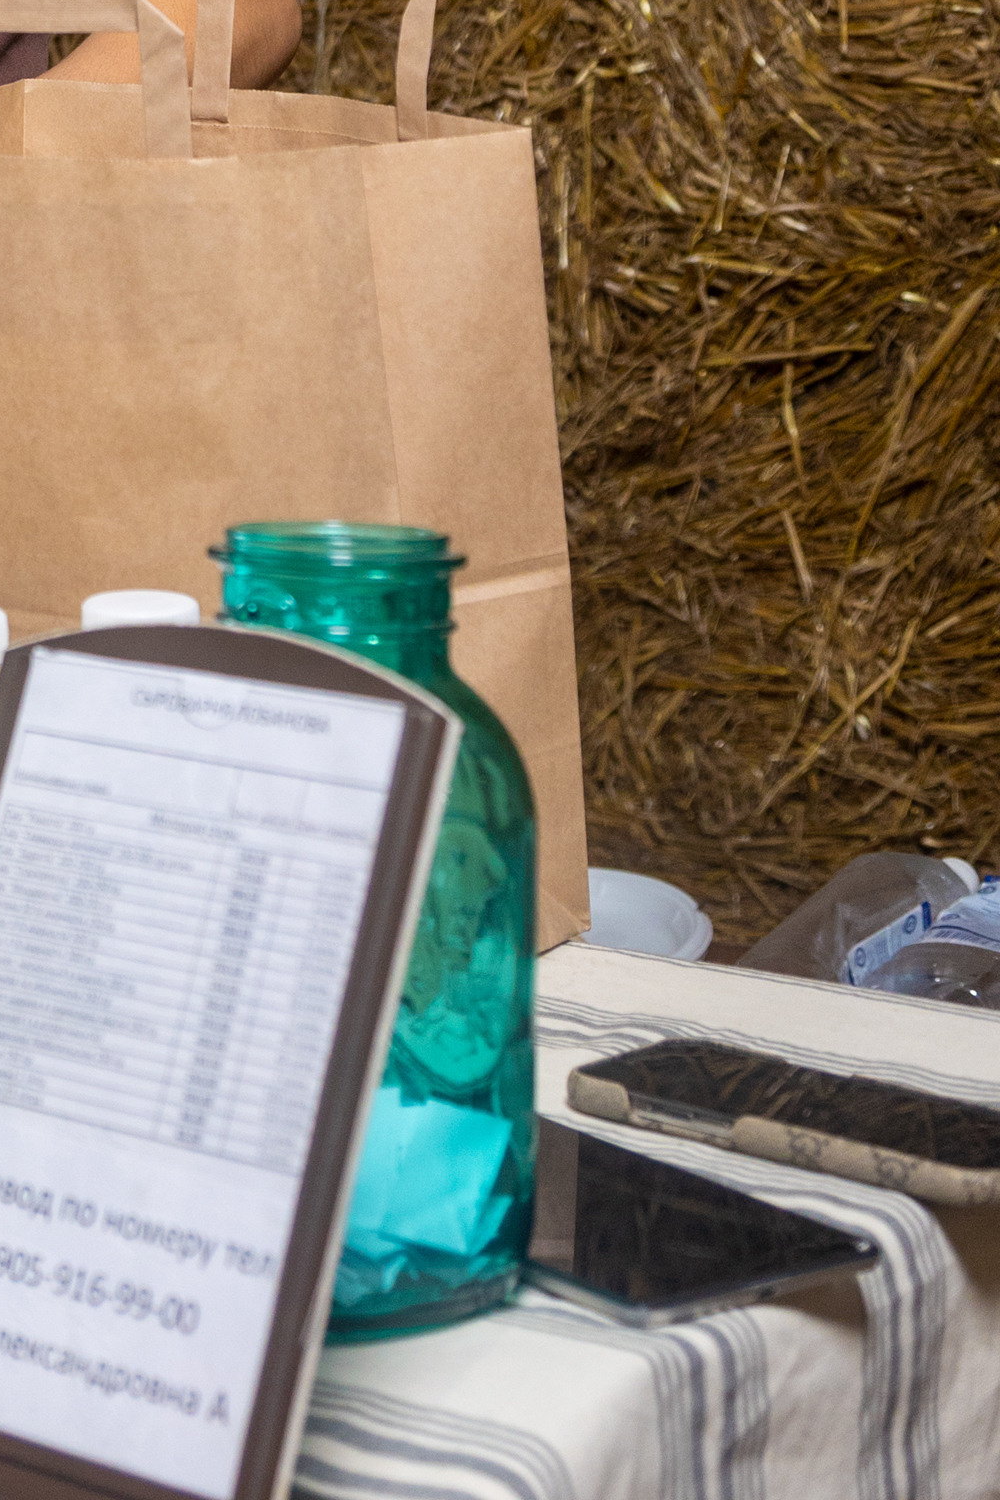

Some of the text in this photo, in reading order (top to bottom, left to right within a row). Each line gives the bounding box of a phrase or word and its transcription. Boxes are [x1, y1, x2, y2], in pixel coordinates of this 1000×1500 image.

[58, 1194, 98, 1229] по
[103, 1210, 218, 1266] номеру
[207, 1392, 229, 1424] А
